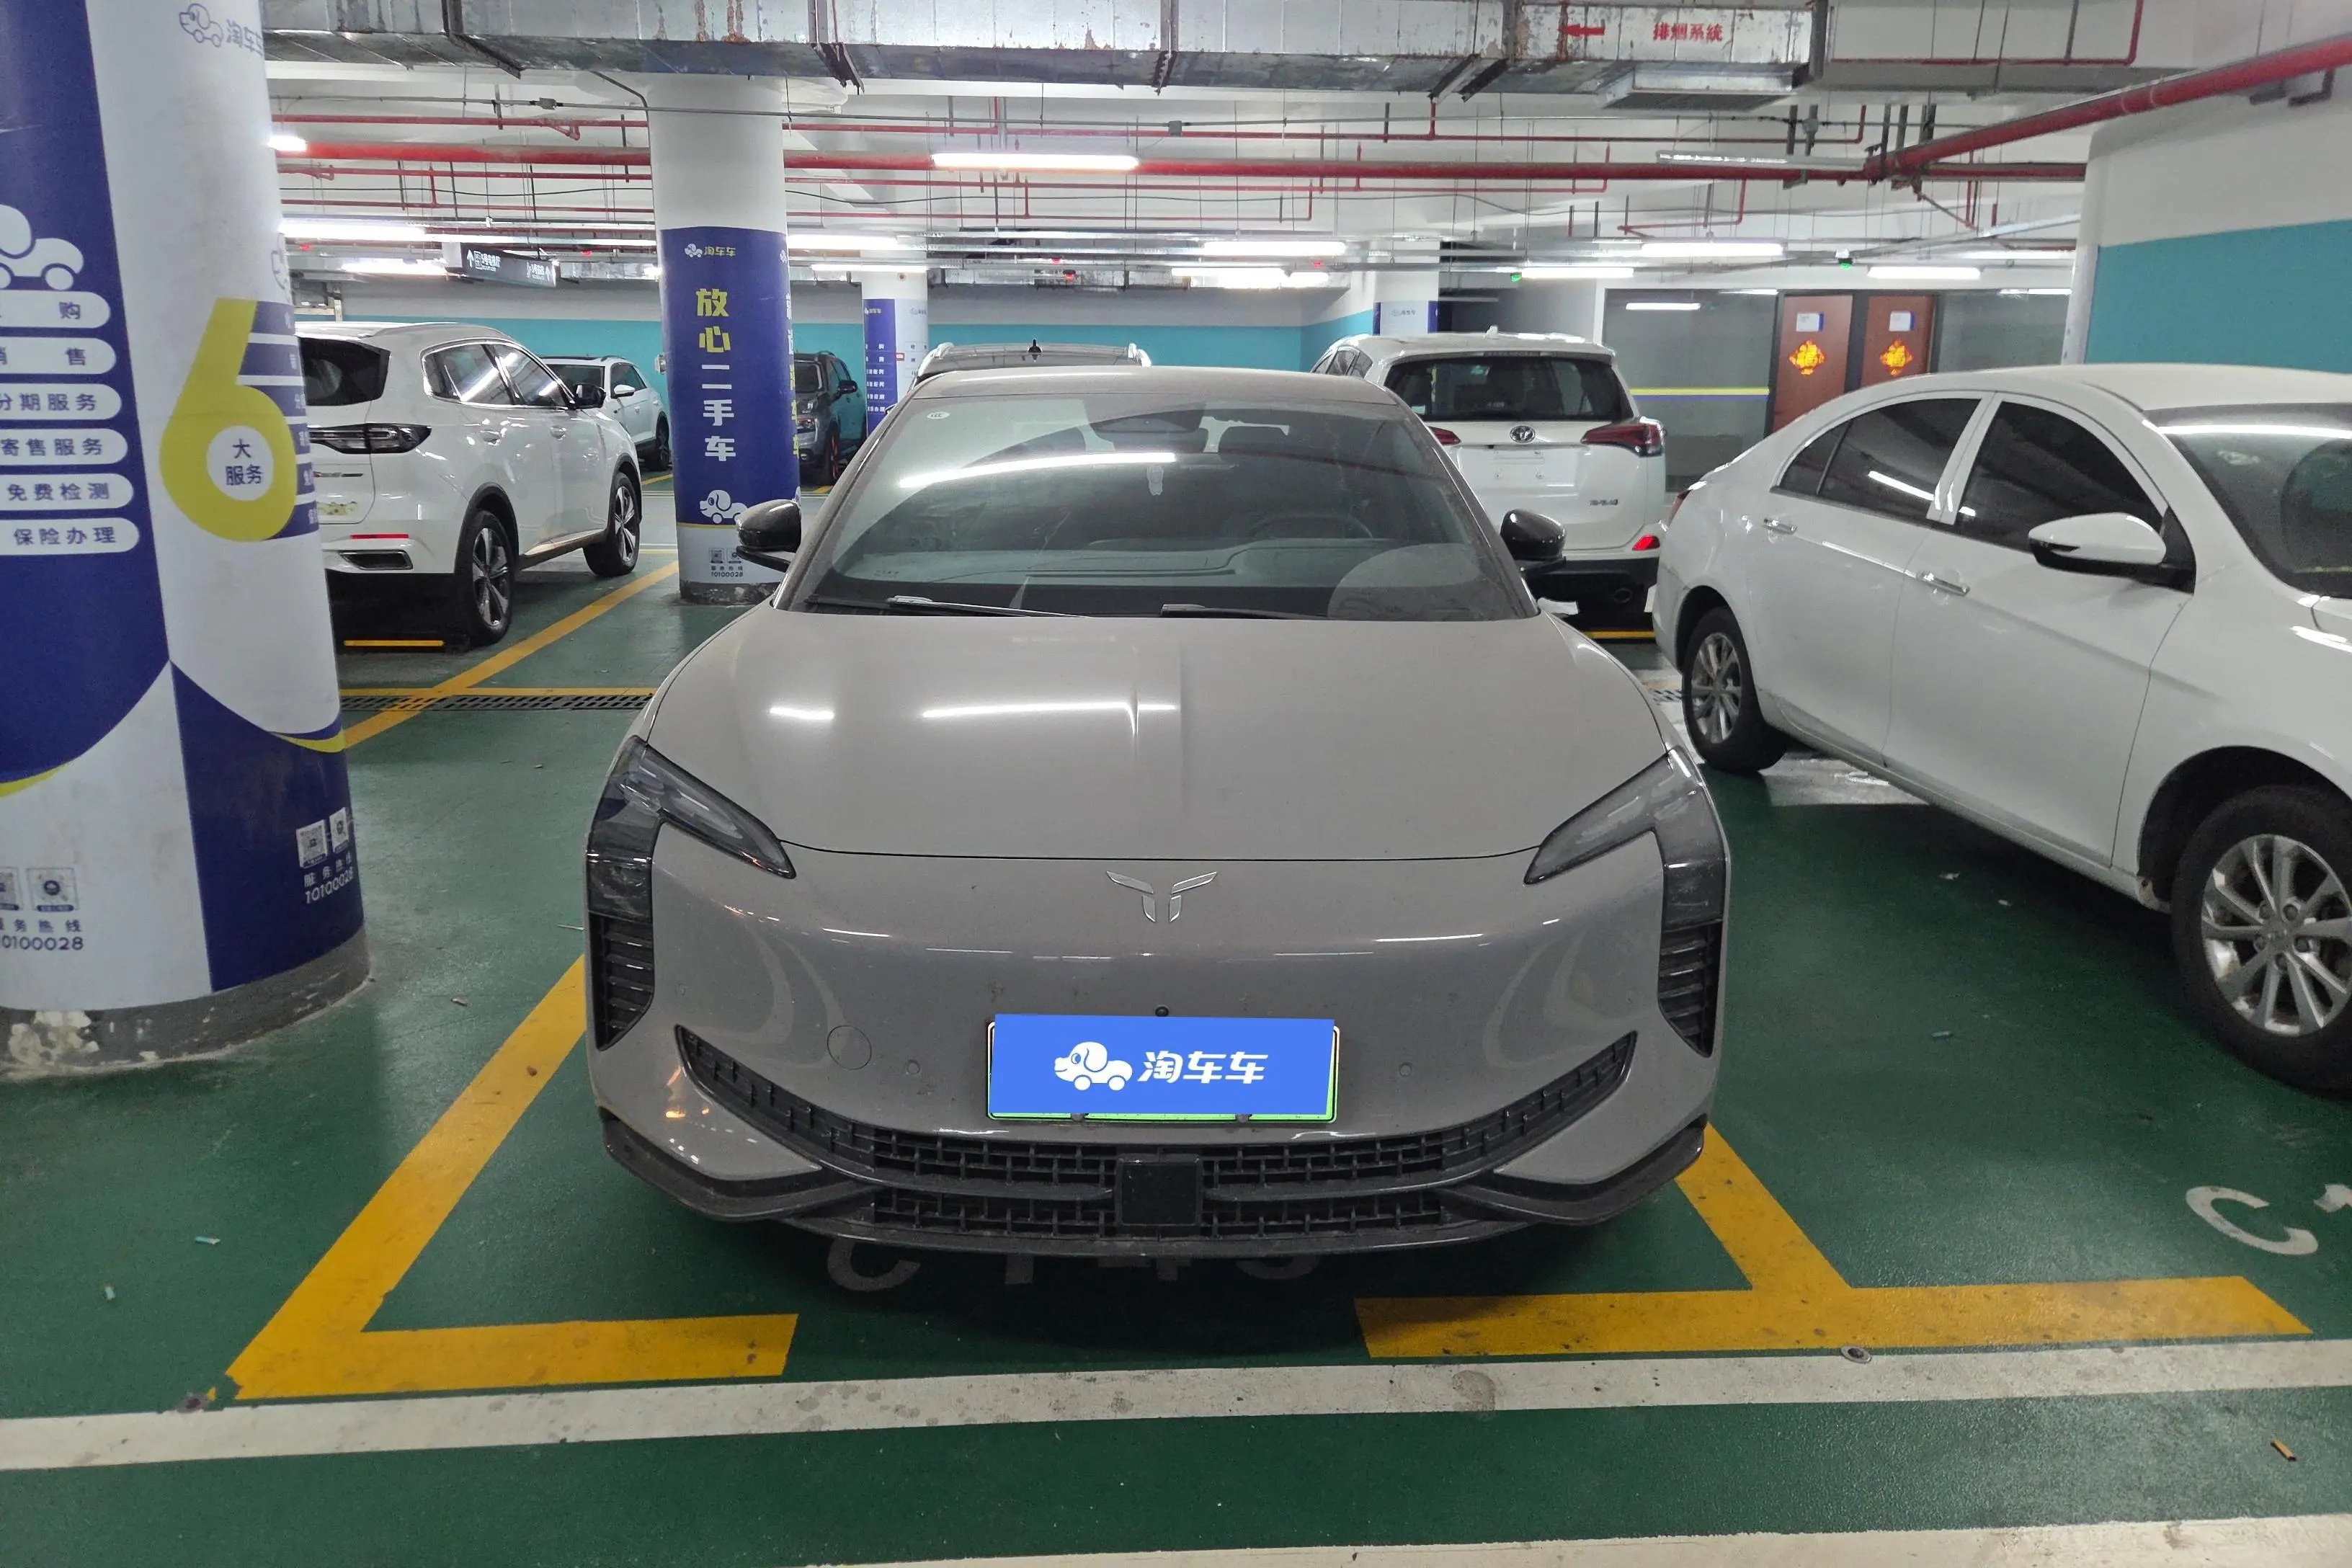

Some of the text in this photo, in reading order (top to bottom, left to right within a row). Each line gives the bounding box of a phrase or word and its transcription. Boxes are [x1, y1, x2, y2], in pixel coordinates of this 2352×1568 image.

[695, 288, 736, 462] 放心二手车
[0, 393, 97, 411] 分期服务
[159, 297, 298, 542] 6
[1, 438, 103, 456] 寄售服务
[225, 465, 264, 486] 服务
[7, 483, 110, 501] 免费检测
[14, 527, 117, 545] 保险办理
